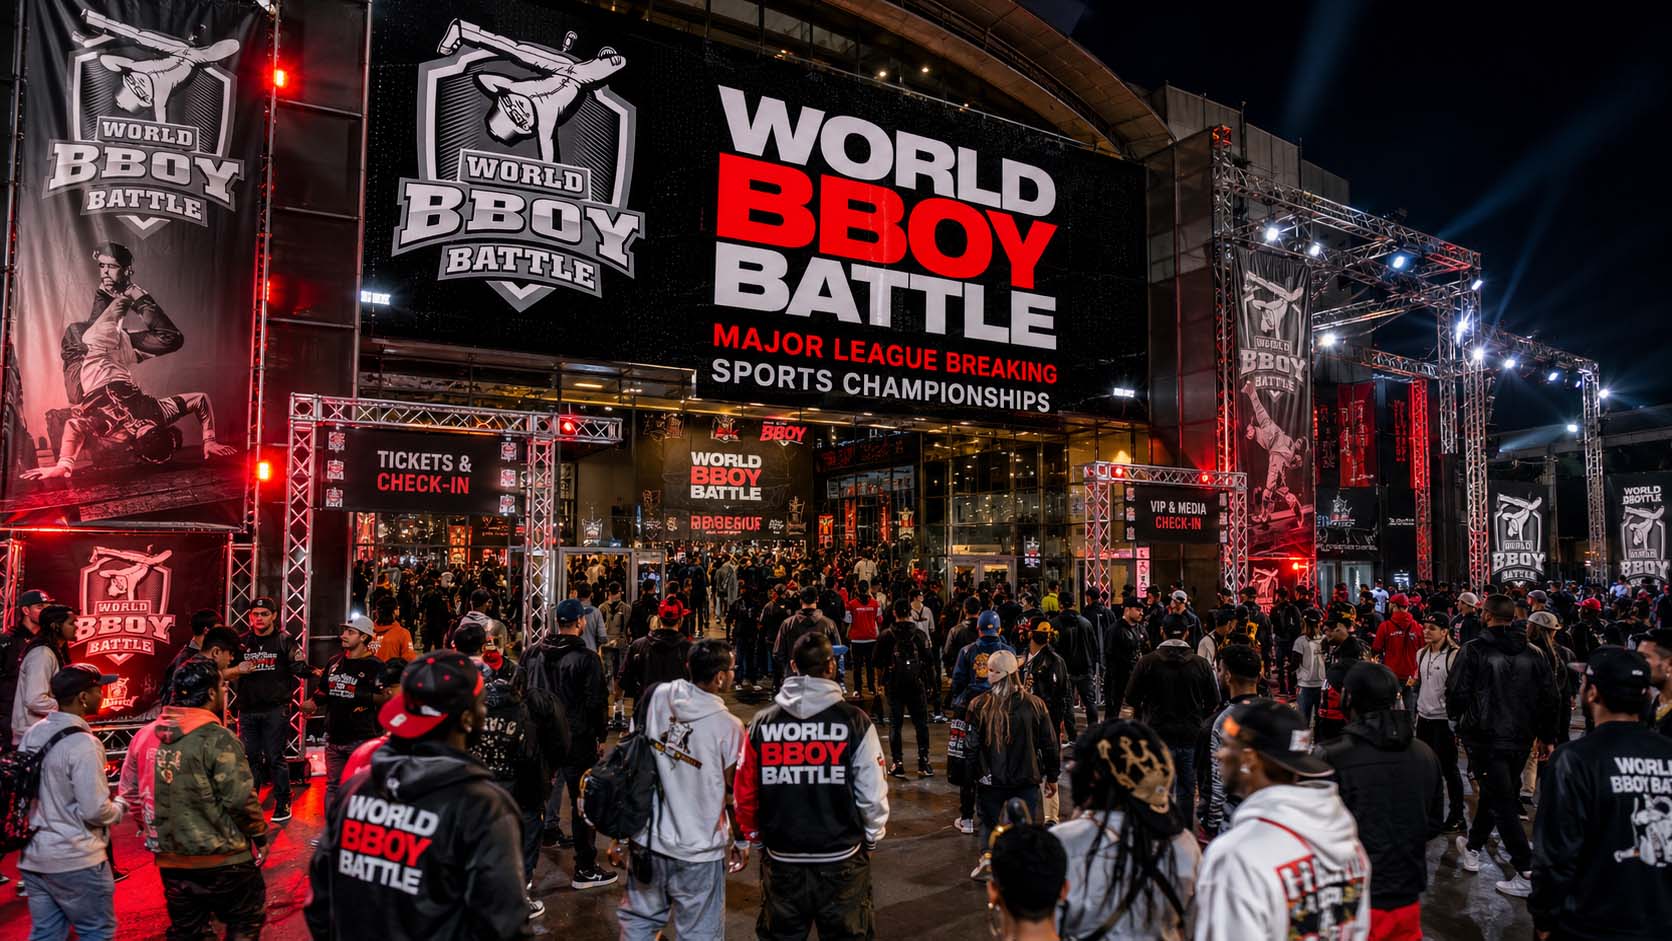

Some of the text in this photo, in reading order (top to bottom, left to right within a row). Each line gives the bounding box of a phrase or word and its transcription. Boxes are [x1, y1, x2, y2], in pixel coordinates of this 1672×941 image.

[103, 121, 193, 146] WORLD
[718, 85, 1056, 217] WORLD
[49, 143, 239, 204] BBOY
[467, 156, 583, 193] WORLD
[87, 188, 202, 219] BATTLE
[399, 182, 640, 268] BBOY
[716, 153, 1058, 289] BBOY
[446, 246, 595, 290] BATTLE
[714, 242, 1057, 349] BATTLE
[713, 322, 1058, 384] MAJOR LEAGUE BREAKING
[1240, 349, 1305, 382] BBOY
[711, 358, 1052, 413] SPORTS CHAMPIONSHIPS
[759, 424, 808, 442] BBOY
[377, 450, 472, 473] TICKETS &
[691, 451, 762, 467] WORLD
[376, 472, 471, 495] CHECK-IN
[690, 466, 762, 487] BBOY
[690, 485, 762, 501] BATTLE
[1624, 486, 1661, 495] WORLD
[1150, 500, 1207, 515] VIP & MEDIA
[1155, 516, 1202, 530] CHECK-IN
[1492, 552, 1545, 573] BBOY
[1620, 560, 1670, 580] BBOY
[98, 602, 148, 613] WORLD
[75, 615, 173, 641] BBOY
[89, 639, 152, 653] BATTLE
[762, 721, 849, 743] WORLD
[761, 742, 848, 767] BBOY
[761, 765, 846, 785] BATTLE
[1610, 775, 1649, 794] BBOY
[347, 795, 439, 837] WORLD
[341, 818, 432, 868] BBOY
[338, 849, 423, 896] BATTLE
